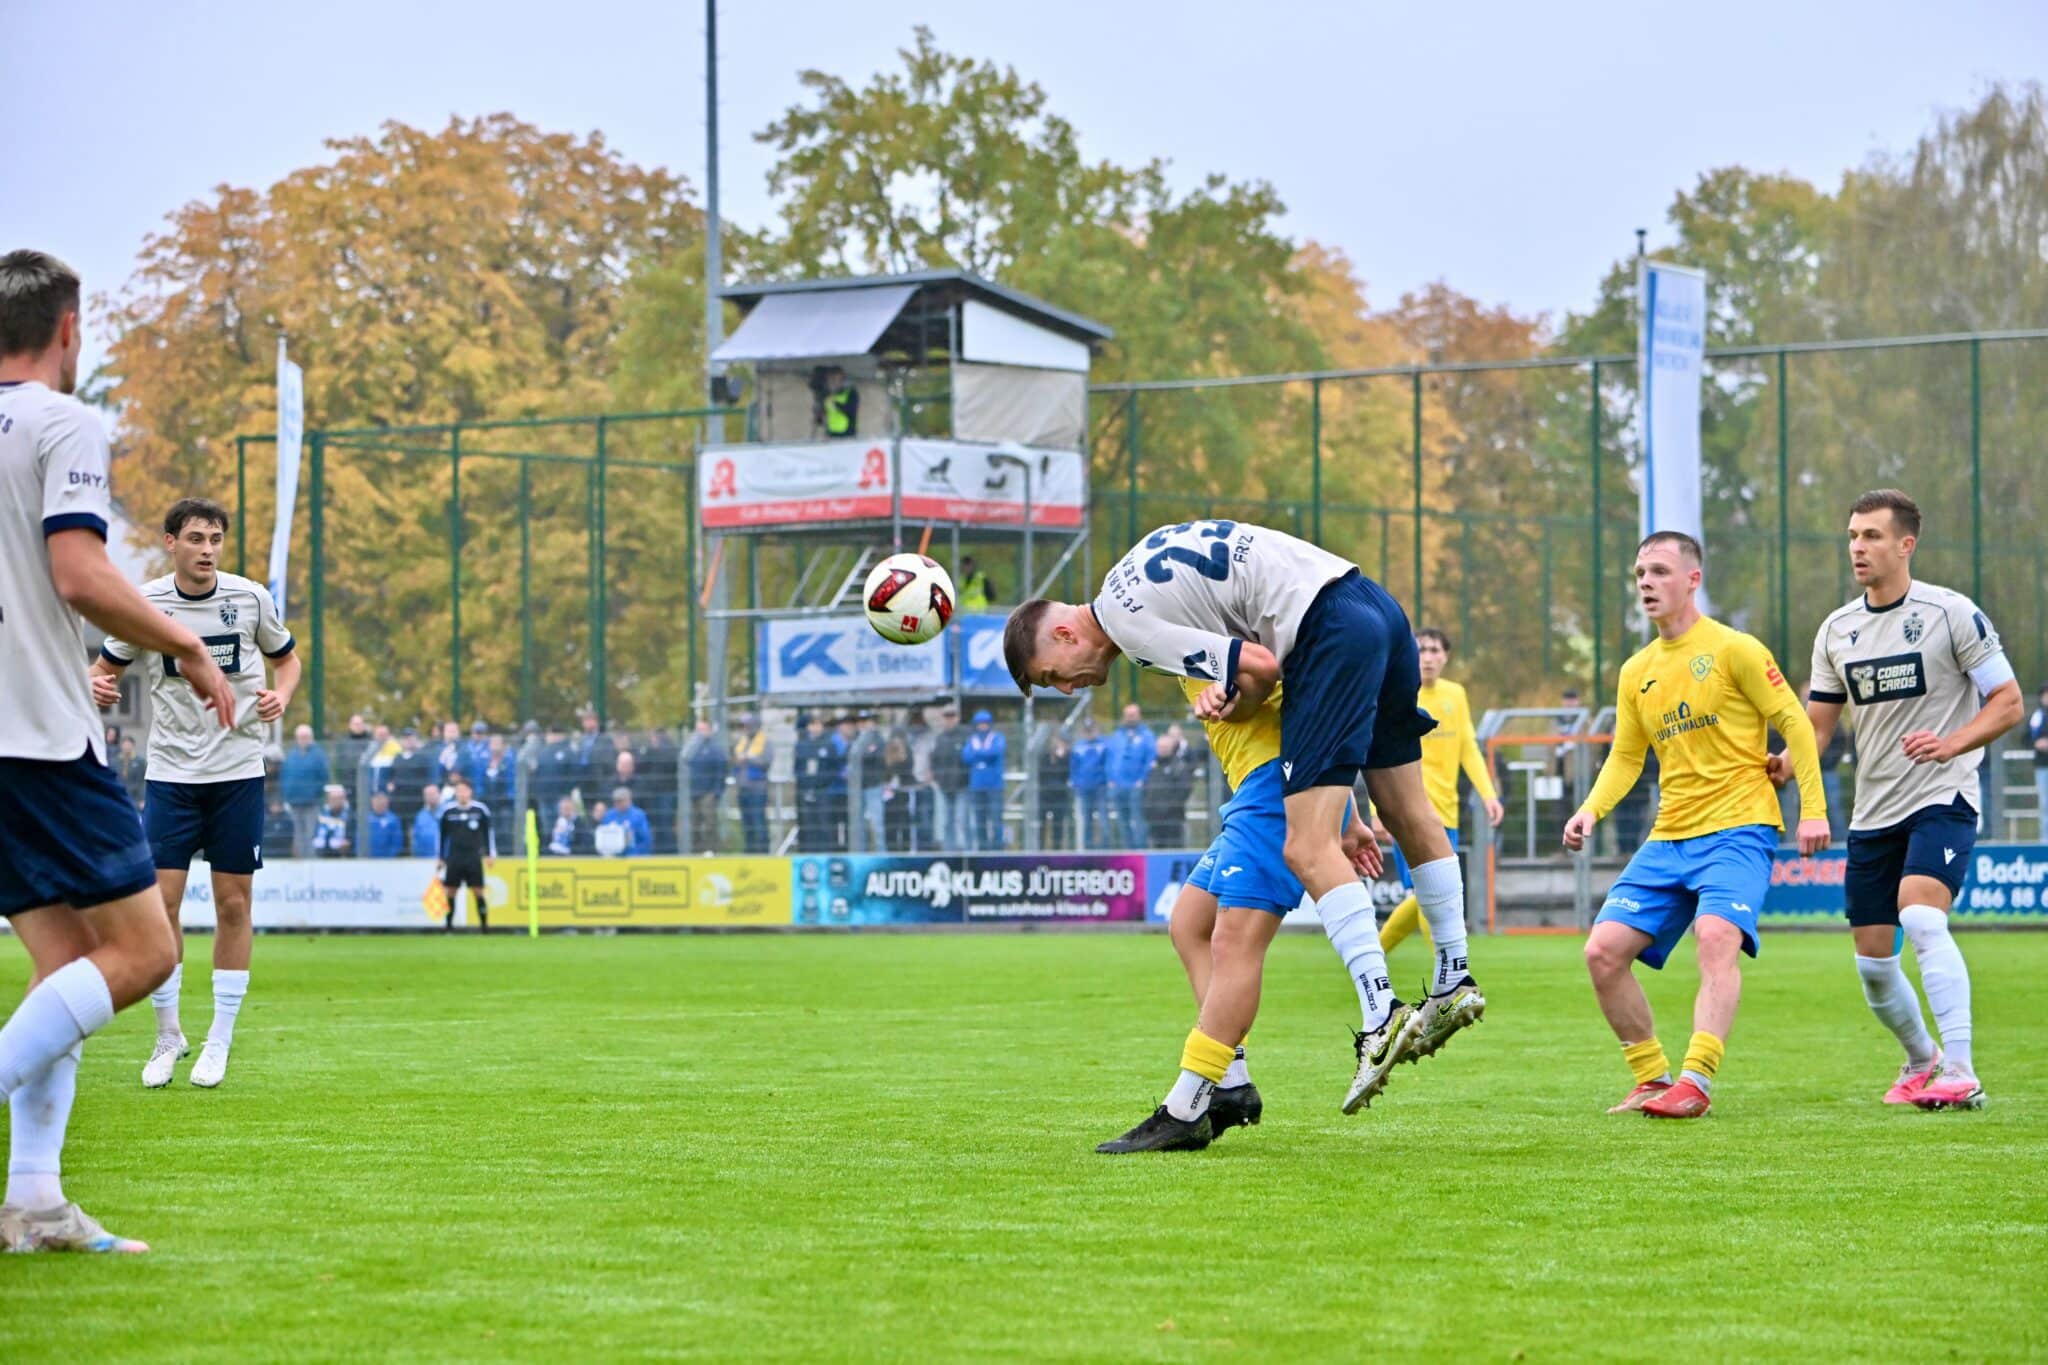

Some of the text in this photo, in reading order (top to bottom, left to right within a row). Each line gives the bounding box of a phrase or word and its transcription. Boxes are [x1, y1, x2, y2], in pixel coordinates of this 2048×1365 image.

[69, 471, 107, 488] BRY
[1877, 663, 1916, 680] COBRA
[1879, 676, 1918, 692] CARDS
[1663, 710, 1679, 725] DIE
[865, 865, 1135, 897] AUTO KLAUS JÜTERBOG
[285, 883, 384, 903] Luckenwalde
